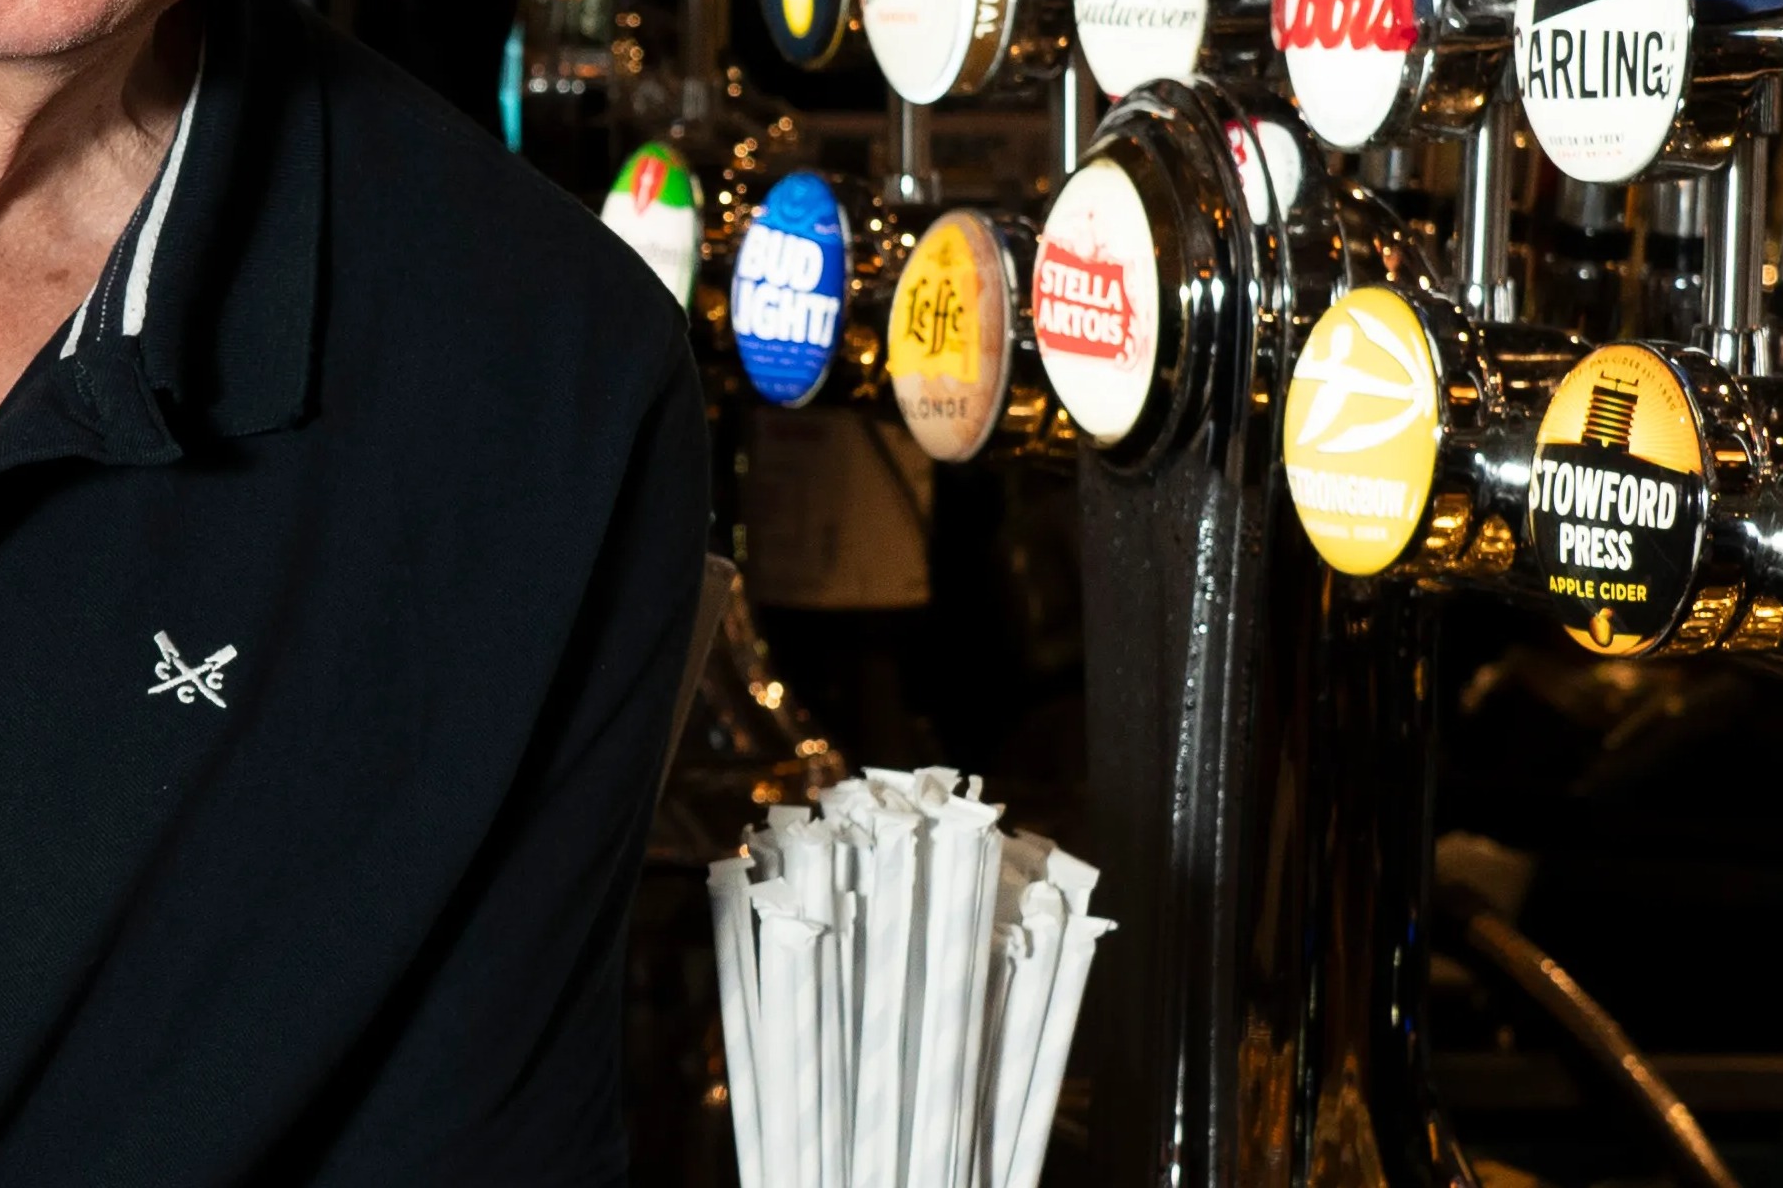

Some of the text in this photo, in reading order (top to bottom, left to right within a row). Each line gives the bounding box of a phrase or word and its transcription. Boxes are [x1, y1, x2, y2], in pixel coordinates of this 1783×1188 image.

[737, 223, 824, 292] BUD
[1040, 260, 1123, 312] STELLA
[904, 278, 964, 357] Leffe
[1039, 297, 1124, 345] ARTOIS
[1528, 458, 1677, 530] STOWFORD
[1559, 522, 1633, 571] PRESS
[1549, 575, 1647, 602] APPLE CIDER
